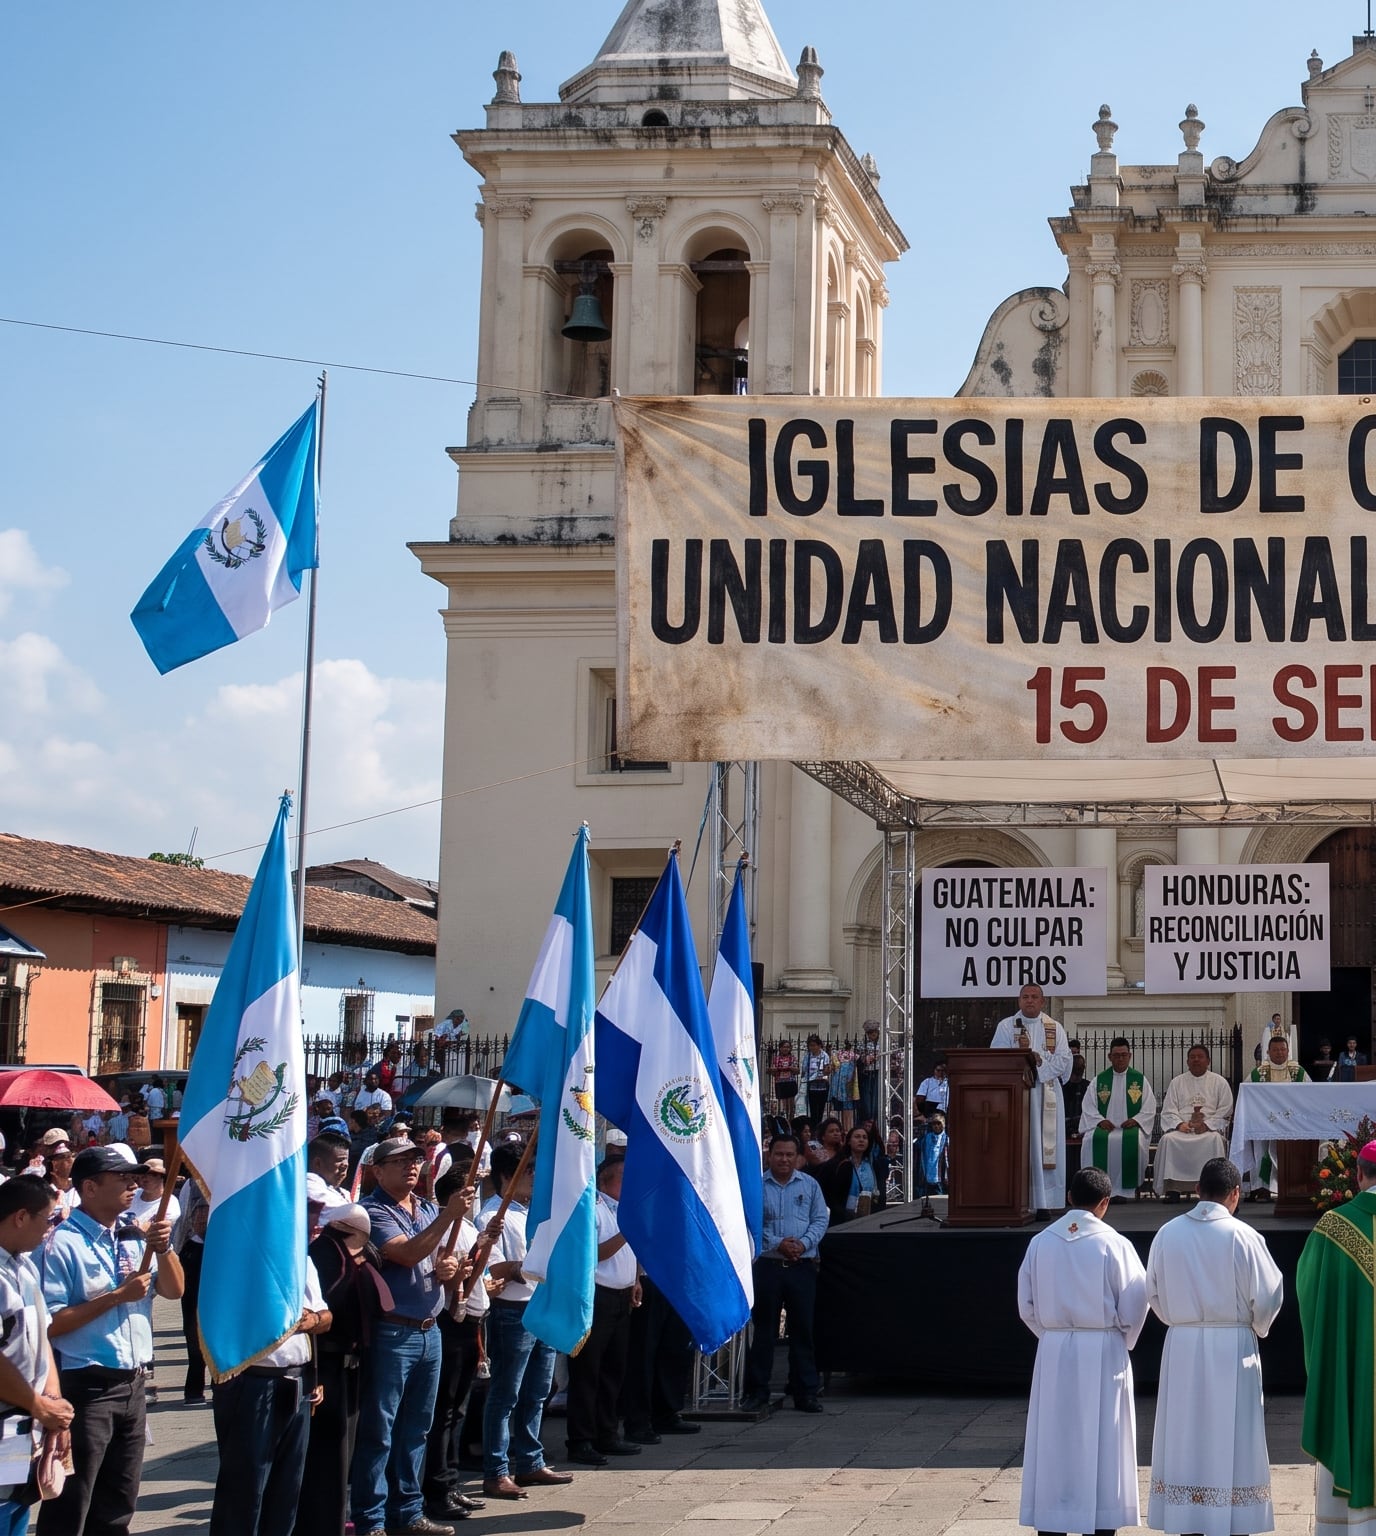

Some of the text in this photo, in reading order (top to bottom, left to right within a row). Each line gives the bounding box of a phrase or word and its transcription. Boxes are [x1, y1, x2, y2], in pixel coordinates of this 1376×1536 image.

[749, 418, 1148, 516] IGLESIAS
[1200, 416, 1305, 513] DE
[651, 539, 952, 644] UNIDAD
[1026, 666, 1108, 744] 15
[1148, 667, 1235, 741] DE
[933, 878, 1094, 908] GUATEMALA:
[1163, 874, 1310, 906] HONDURAS:
[946, 917, 1082, 947] NO CULPAR
[1150, 909, 1323, 943] RECONCILIACIÓN
[962, 956, 1066, 986] A OTROS
[1174, 951, 1300, 980] Y JUSTICIA
